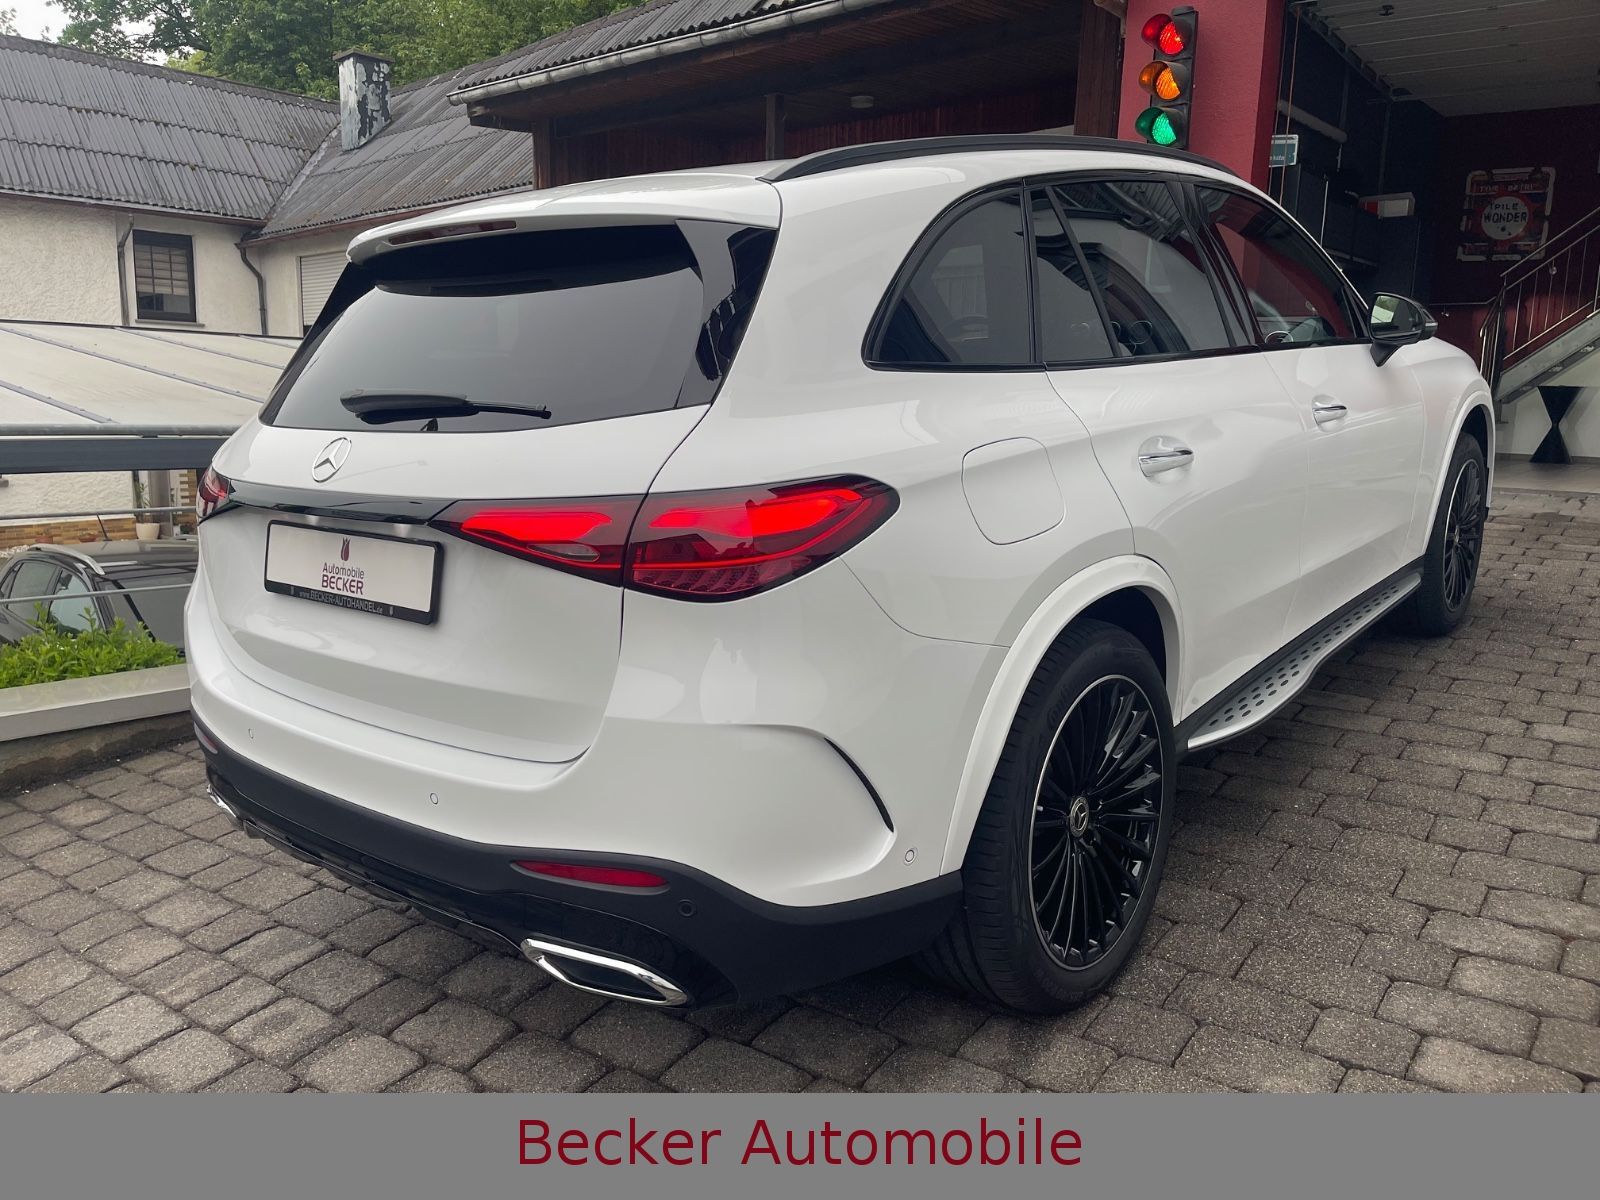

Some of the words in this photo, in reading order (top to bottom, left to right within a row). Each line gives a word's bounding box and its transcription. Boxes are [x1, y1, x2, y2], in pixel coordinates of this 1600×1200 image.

[1483, 211, 1528, 224] WONDER
[322, 561, 365, 580] Automobile
[321, 573, 364, 596] BECKER
